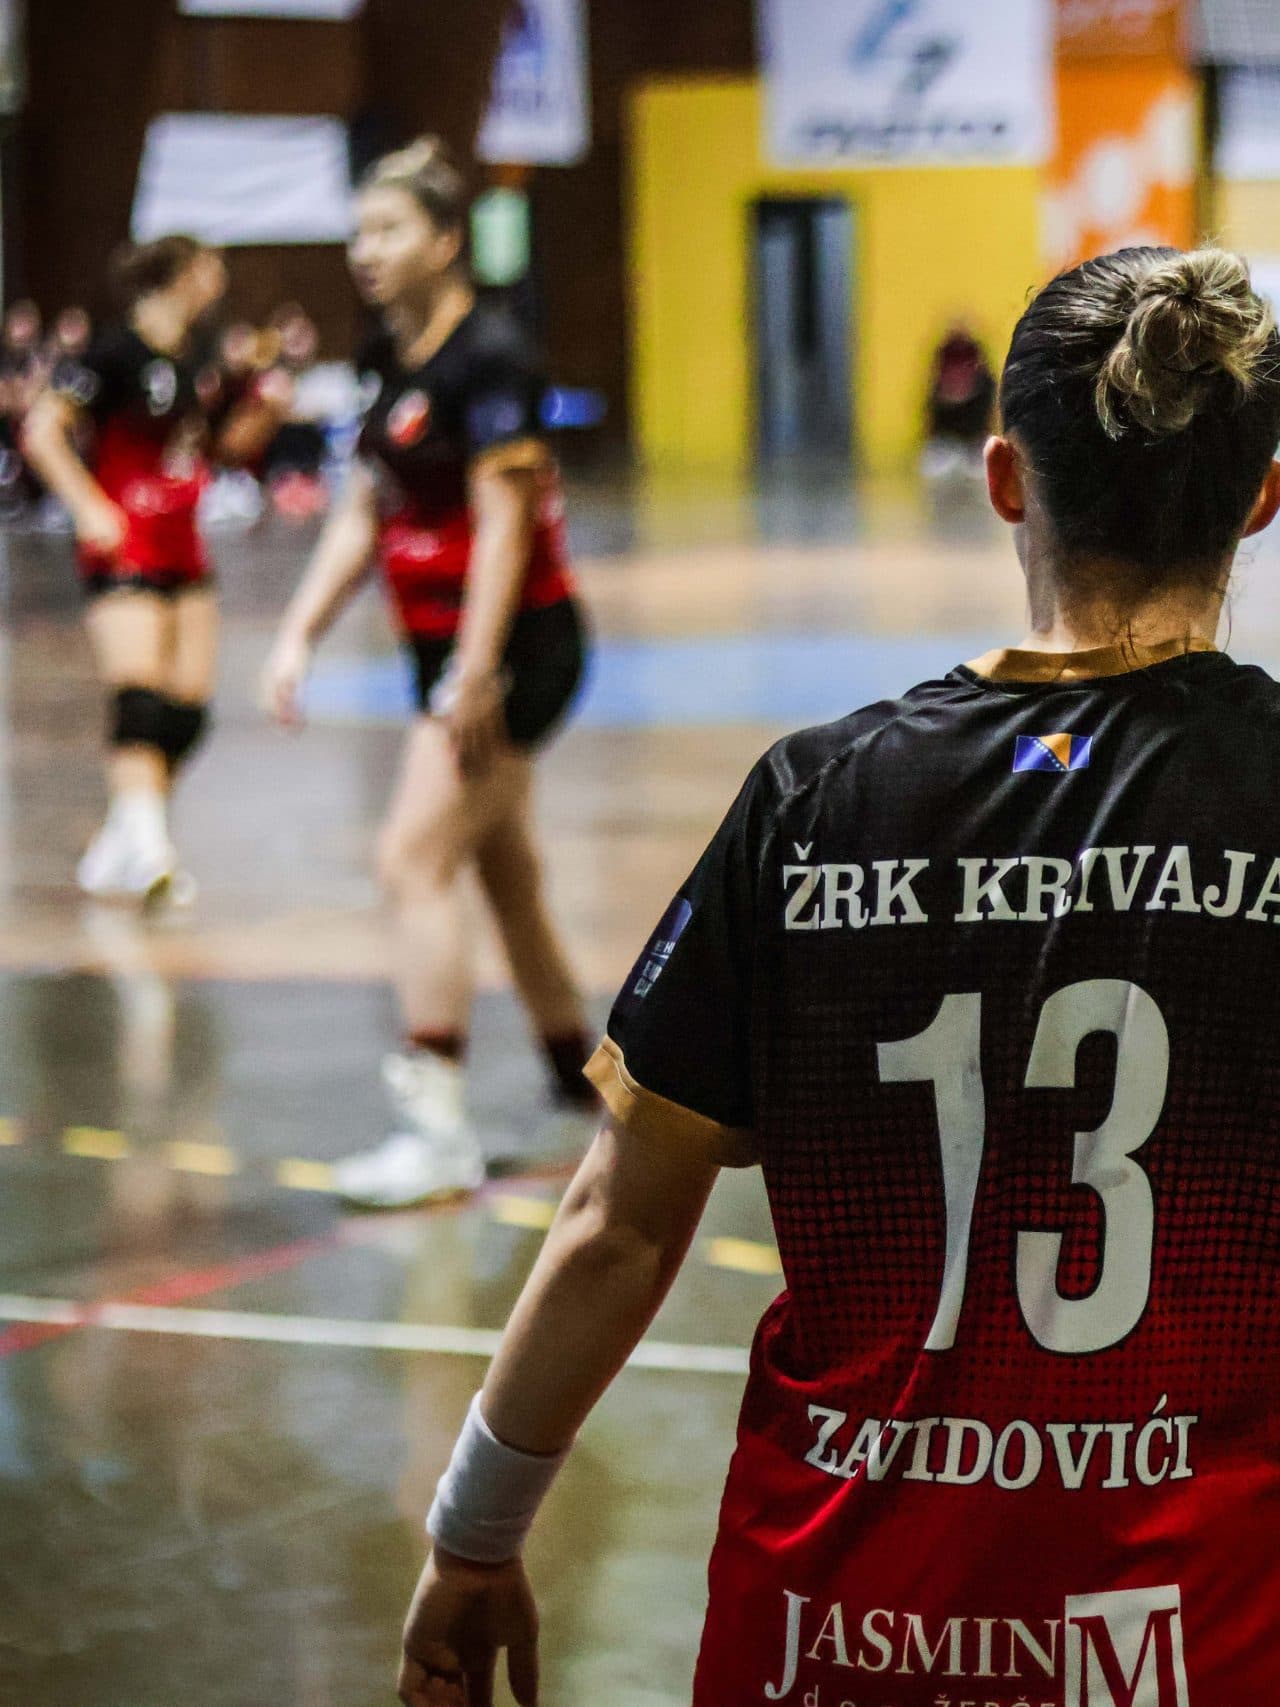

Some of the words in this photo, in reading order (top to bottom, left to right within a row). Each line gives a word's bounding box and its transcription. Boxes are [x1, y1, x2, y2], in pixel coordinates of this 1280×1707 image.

[783, 840, 930, 930] ŽRK
[876, 978, 1171, 1353] 13
[803, 1393, 1199, 1490] ZAVIDOVIĆI
[763, 1588, 1062, 1700] JASMIN
